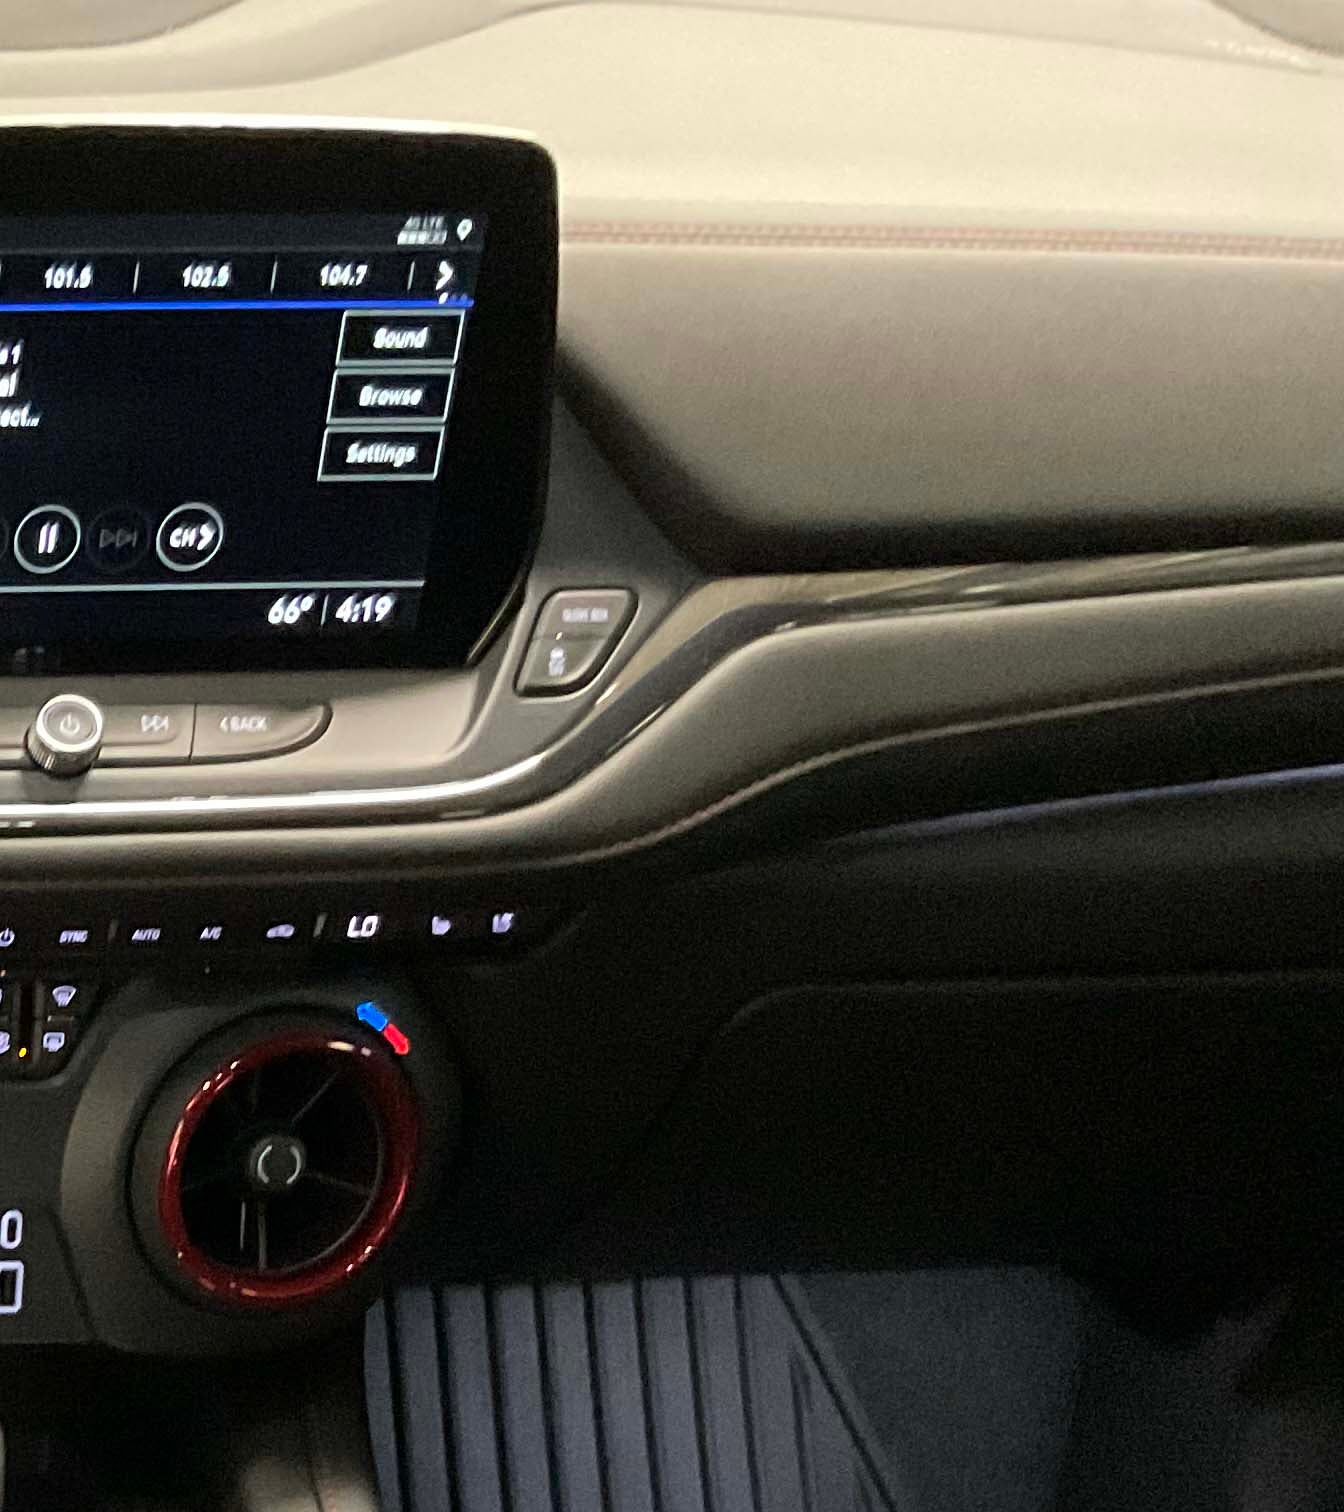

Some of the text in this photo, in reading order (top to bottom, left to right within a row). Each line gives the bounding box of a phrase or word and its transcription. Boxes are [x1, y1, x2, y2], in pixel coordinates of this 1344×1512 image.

[320, 262, 368, 286] 104.7
[373, 328, 429, 350] Sound
[11, 341, 22, 365] 1
[358, 386, 424, 407] Browse
[345, 443, 417, 467] Settings
[169, 528, 197, 549] CH
[267, 596, 316, 625] 66°
[335, 596, 395, 623] 4:19
[230, 717, 267, 732] BACK
[59, 930, 88, 944] SYNC
[131, 928, 161, 942] AUTO
[199, 926, 222, 941] A/C
[346, 914, 379, 938] LO
